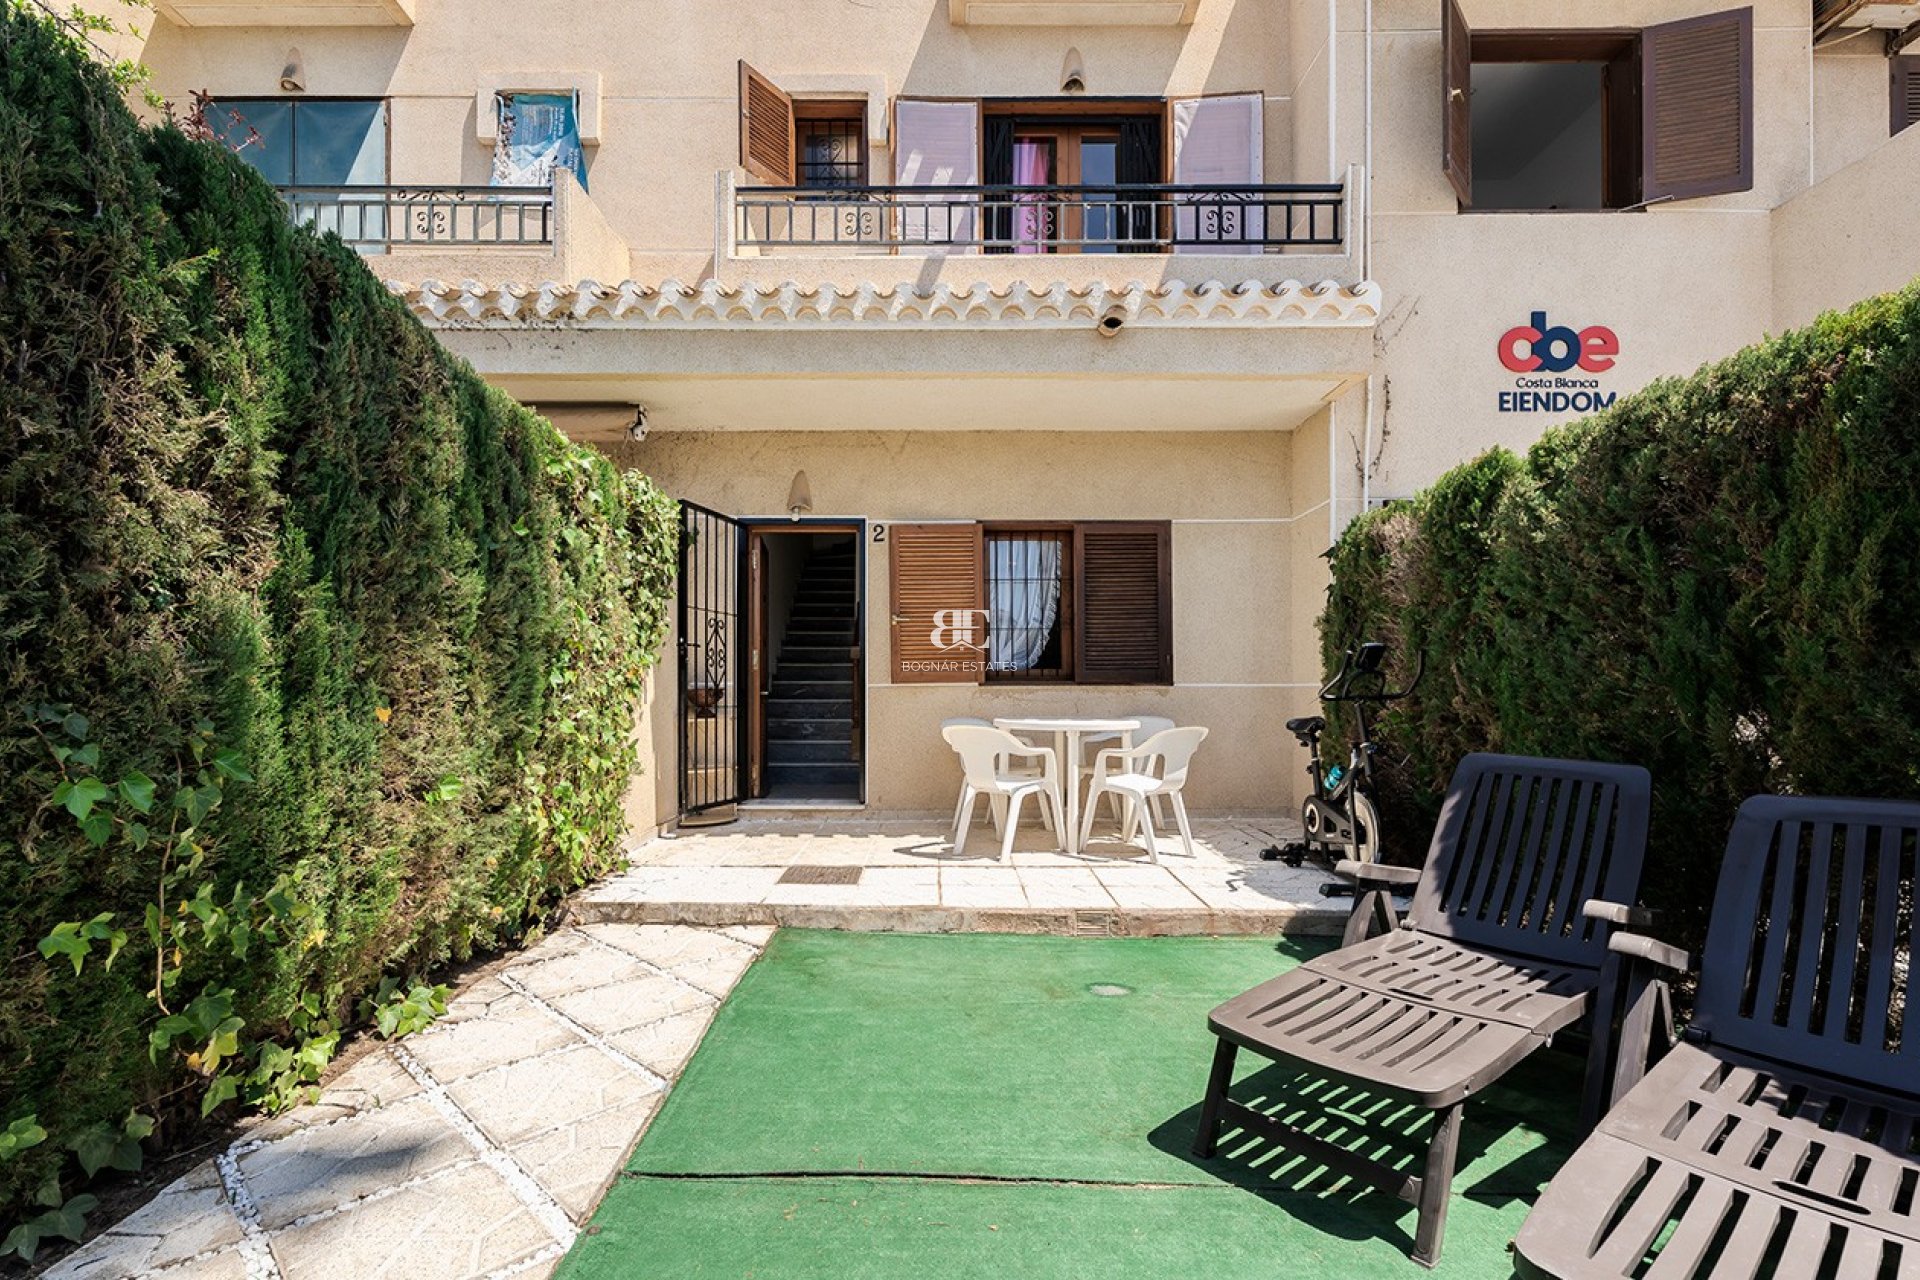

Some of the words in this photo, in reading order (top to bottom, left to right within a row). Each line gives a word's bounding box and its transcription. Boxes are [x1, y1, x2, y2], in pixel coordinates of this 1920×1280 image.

[1498, 311, 1619, 373] cbe
[1516, 378, 1552, 388] Costa
[1555, 378, 1599, 388] Blanca
[1498, 391, 1617, 412] EIENDOM
[873, 523, 885, 542] 2
